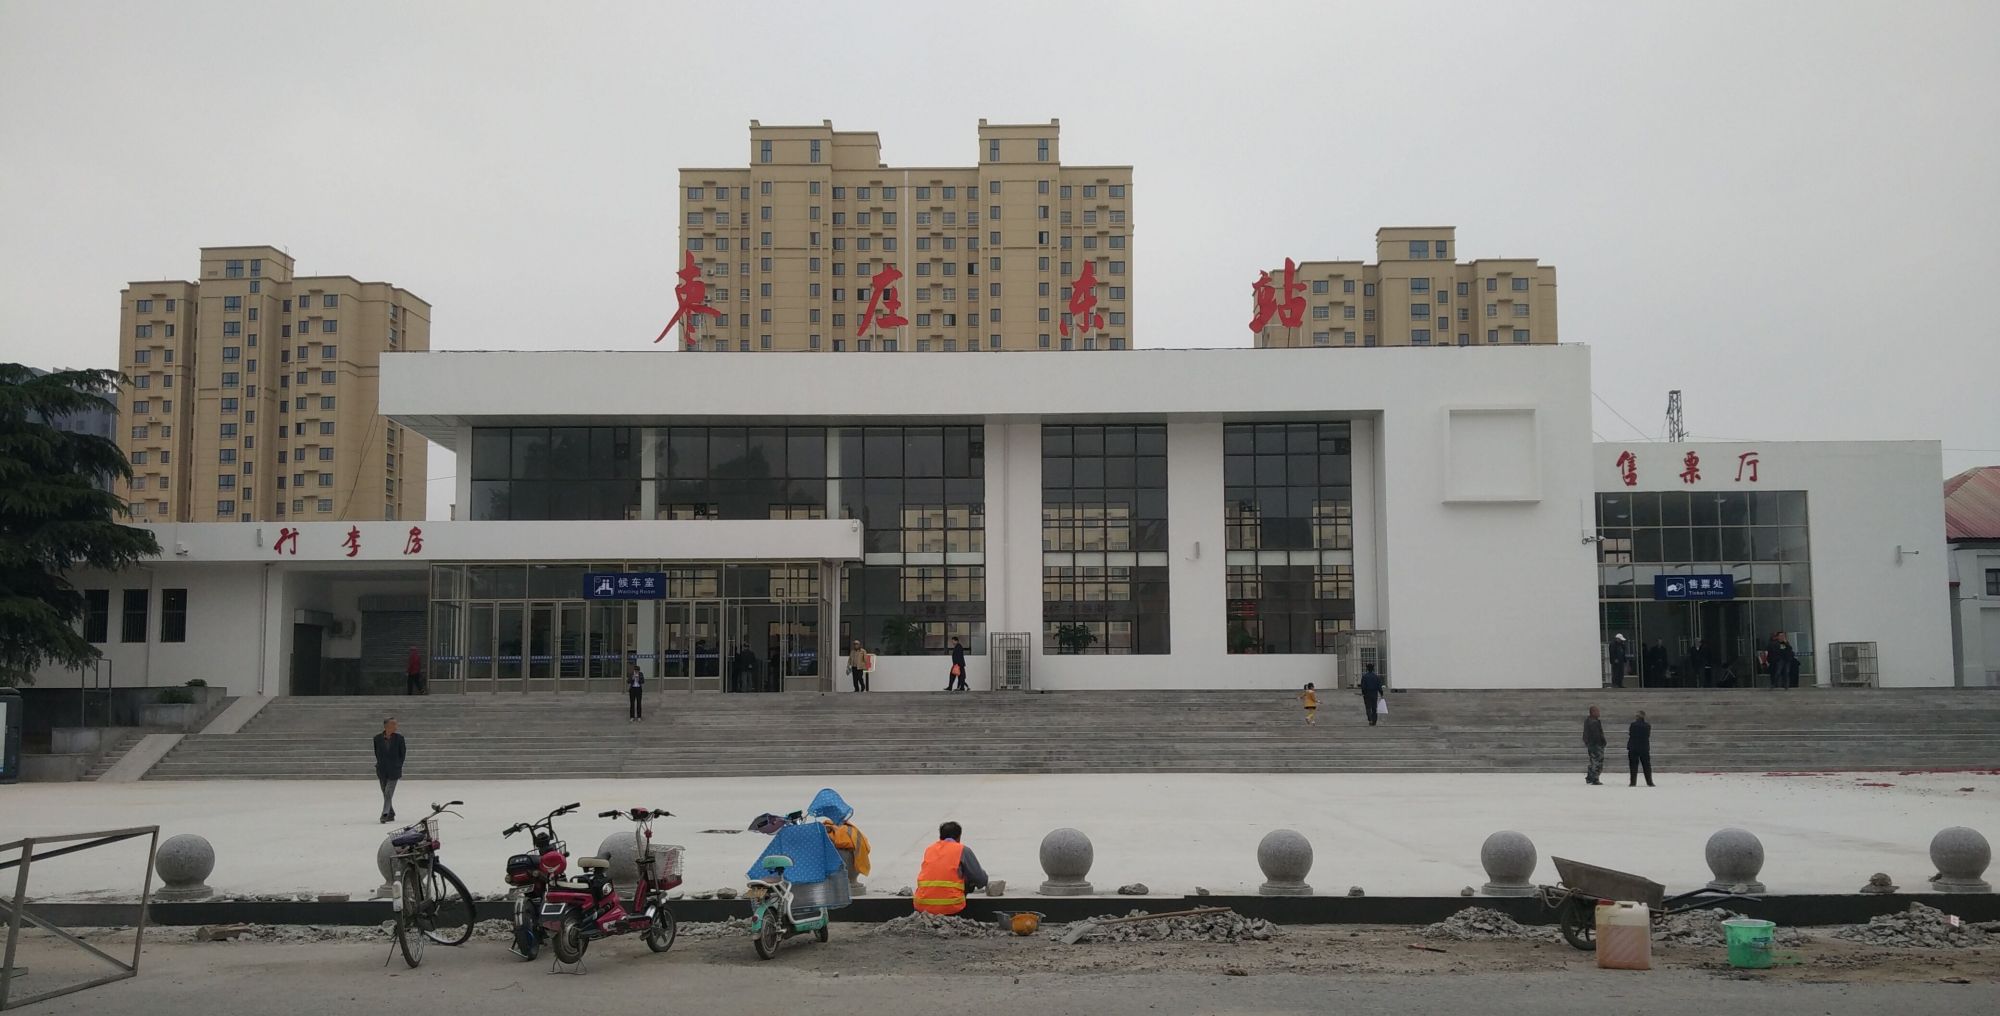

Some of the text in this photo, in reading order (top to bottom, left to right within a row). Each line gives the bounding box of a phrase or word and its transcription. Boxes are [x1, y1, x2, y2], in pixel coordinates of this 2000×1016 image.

[654, 249, 1307, 345] 枣庄东站
[1616, 450, 1759, 486] 售票厅
[274, 525, 424, 557] 行李房
[618, 577, 655, 588] 候车室
[1688, 579, 1724, 589] 售票处
